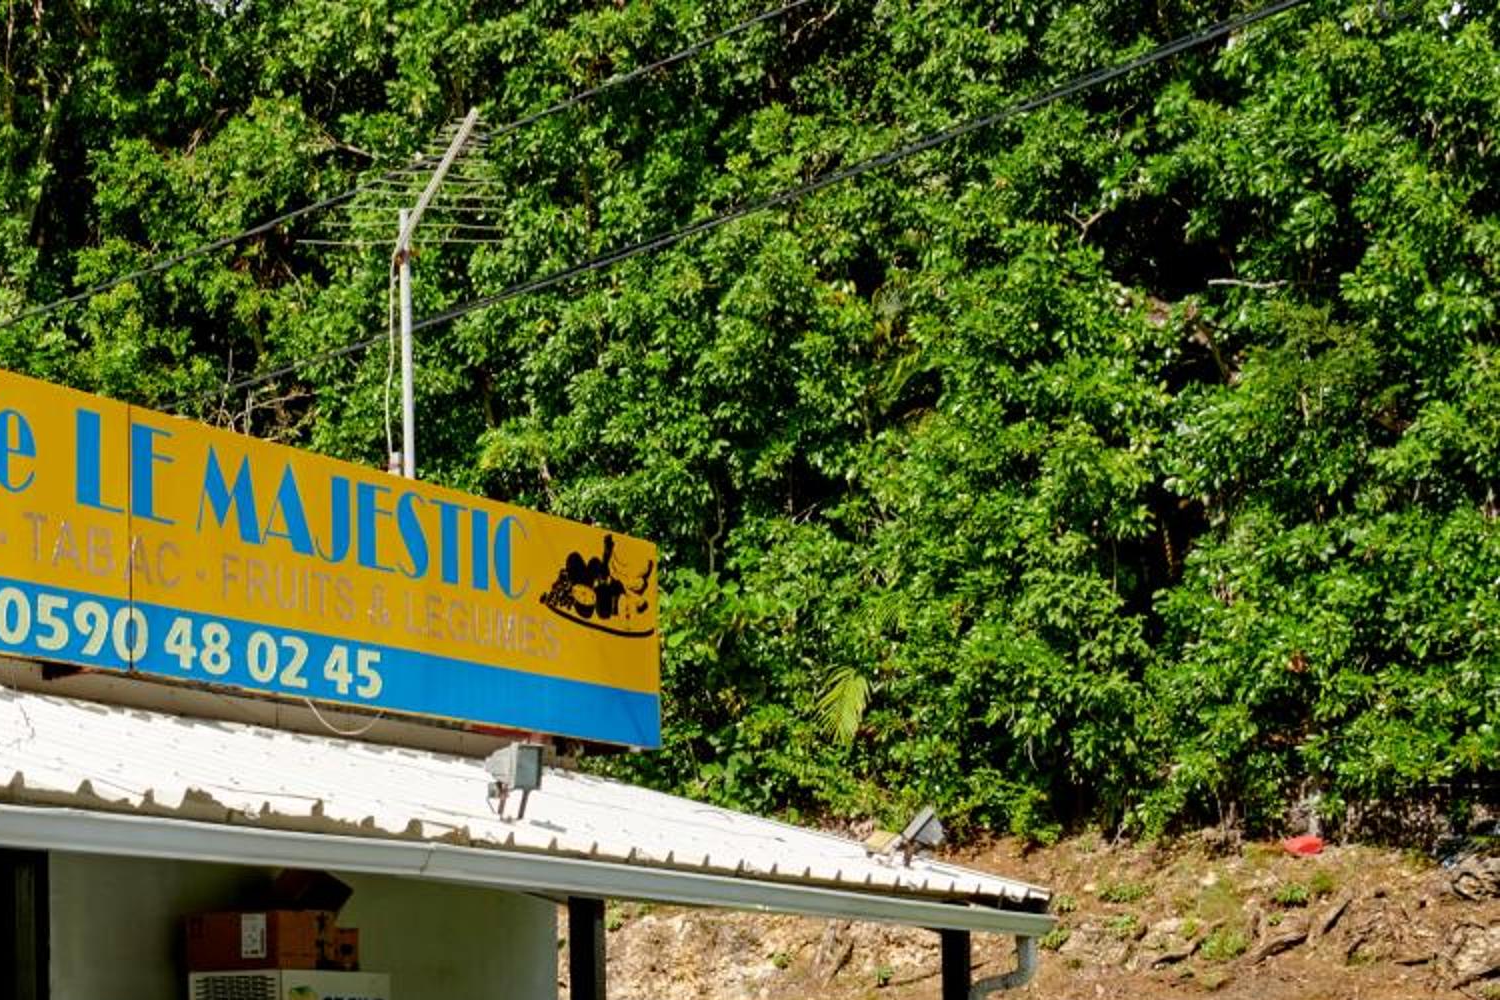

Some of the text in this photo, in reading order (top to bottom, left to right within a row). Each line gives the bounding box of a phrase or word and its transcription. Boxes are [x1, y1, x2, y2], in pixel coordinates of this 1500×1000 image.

[76, 407, 175, 525] LE
[196, 444, 530, 599] MAJESTIC
[22, 510, 183, 590] TABAC
[222, 552, 357, 624] FRUITS
[367, 583, 393, 627] &
[403, 589, 563, 663] LEGUMES
[164, 617, 231, 675] 48
[247, 631, 309, 690] 02
[323, 644, 383, 699] 45
